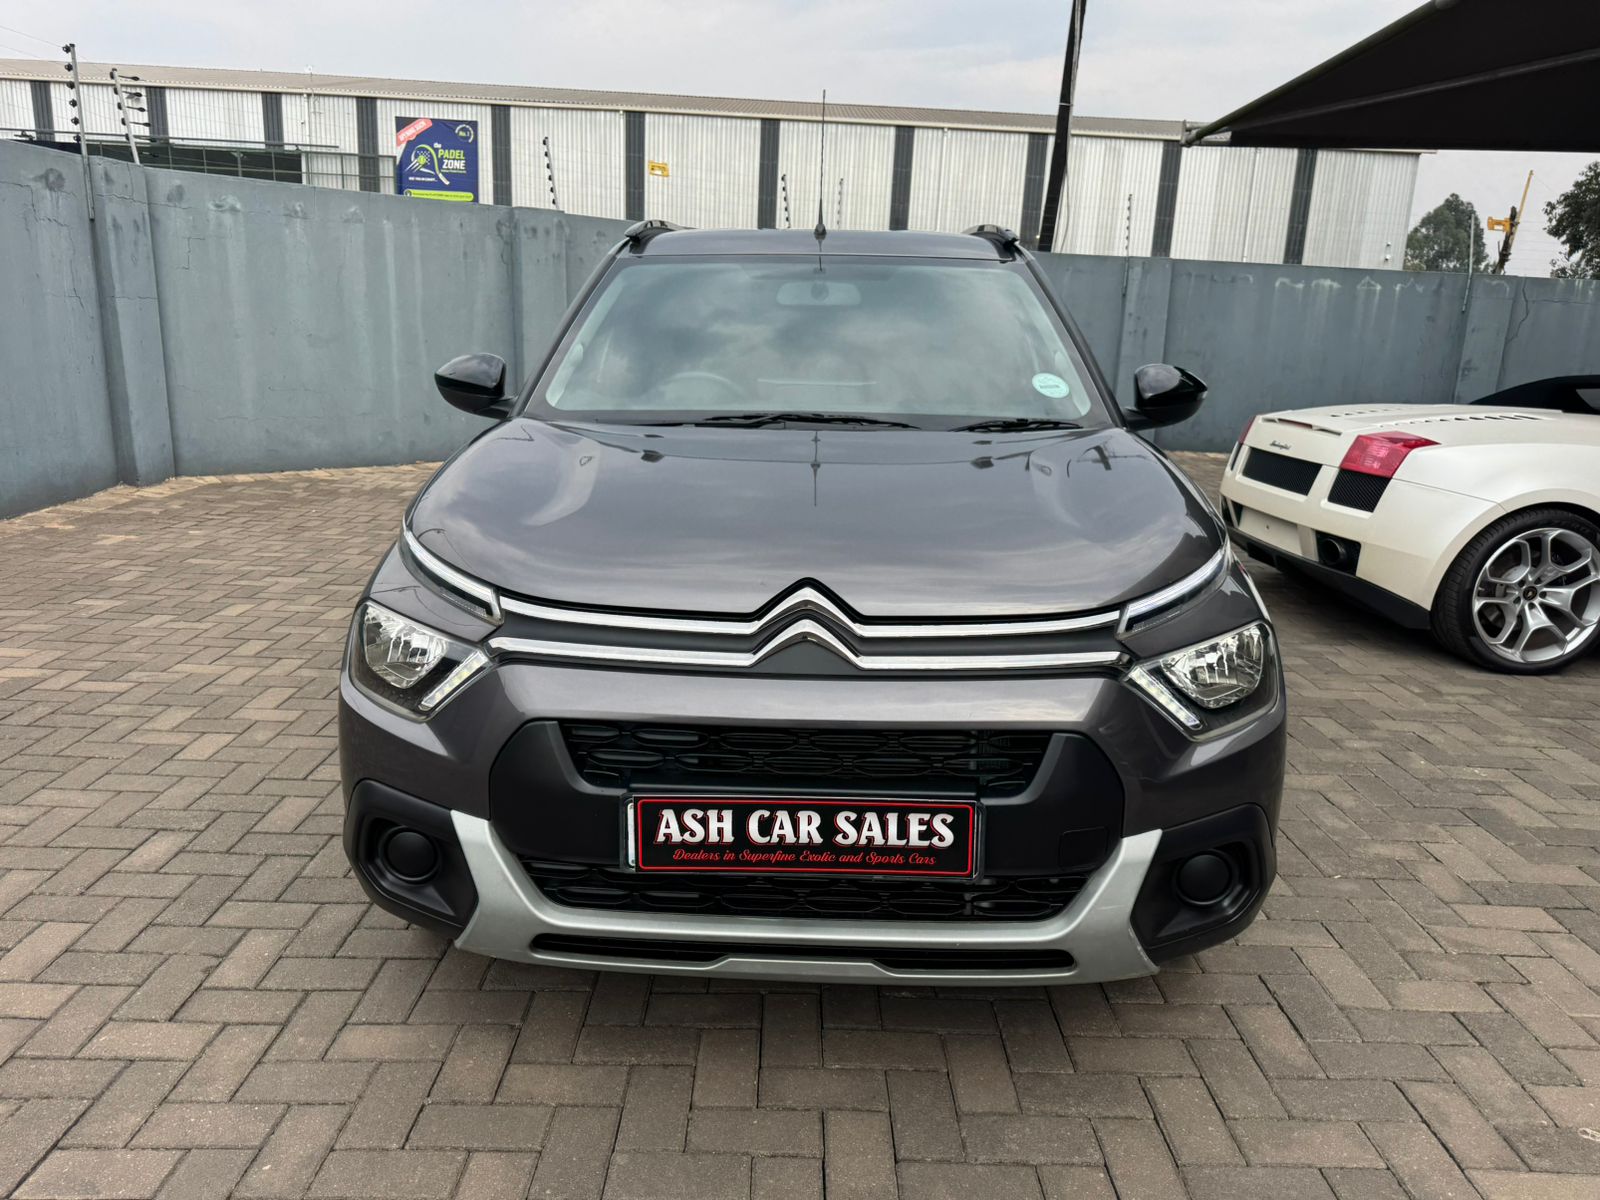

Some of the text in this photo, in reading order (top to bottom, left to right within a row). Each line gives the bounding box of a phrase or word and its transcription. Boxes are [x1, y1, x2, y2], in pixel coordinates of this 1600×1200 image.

[438, 149, 465, 159] PADEL
[442, 160, 466, 169] ZONE
[654, 808, 955, 848] ASH CAR SALES
[672, 849, 936, 865] Dealers in Superfine Exotic and Sports Cars
